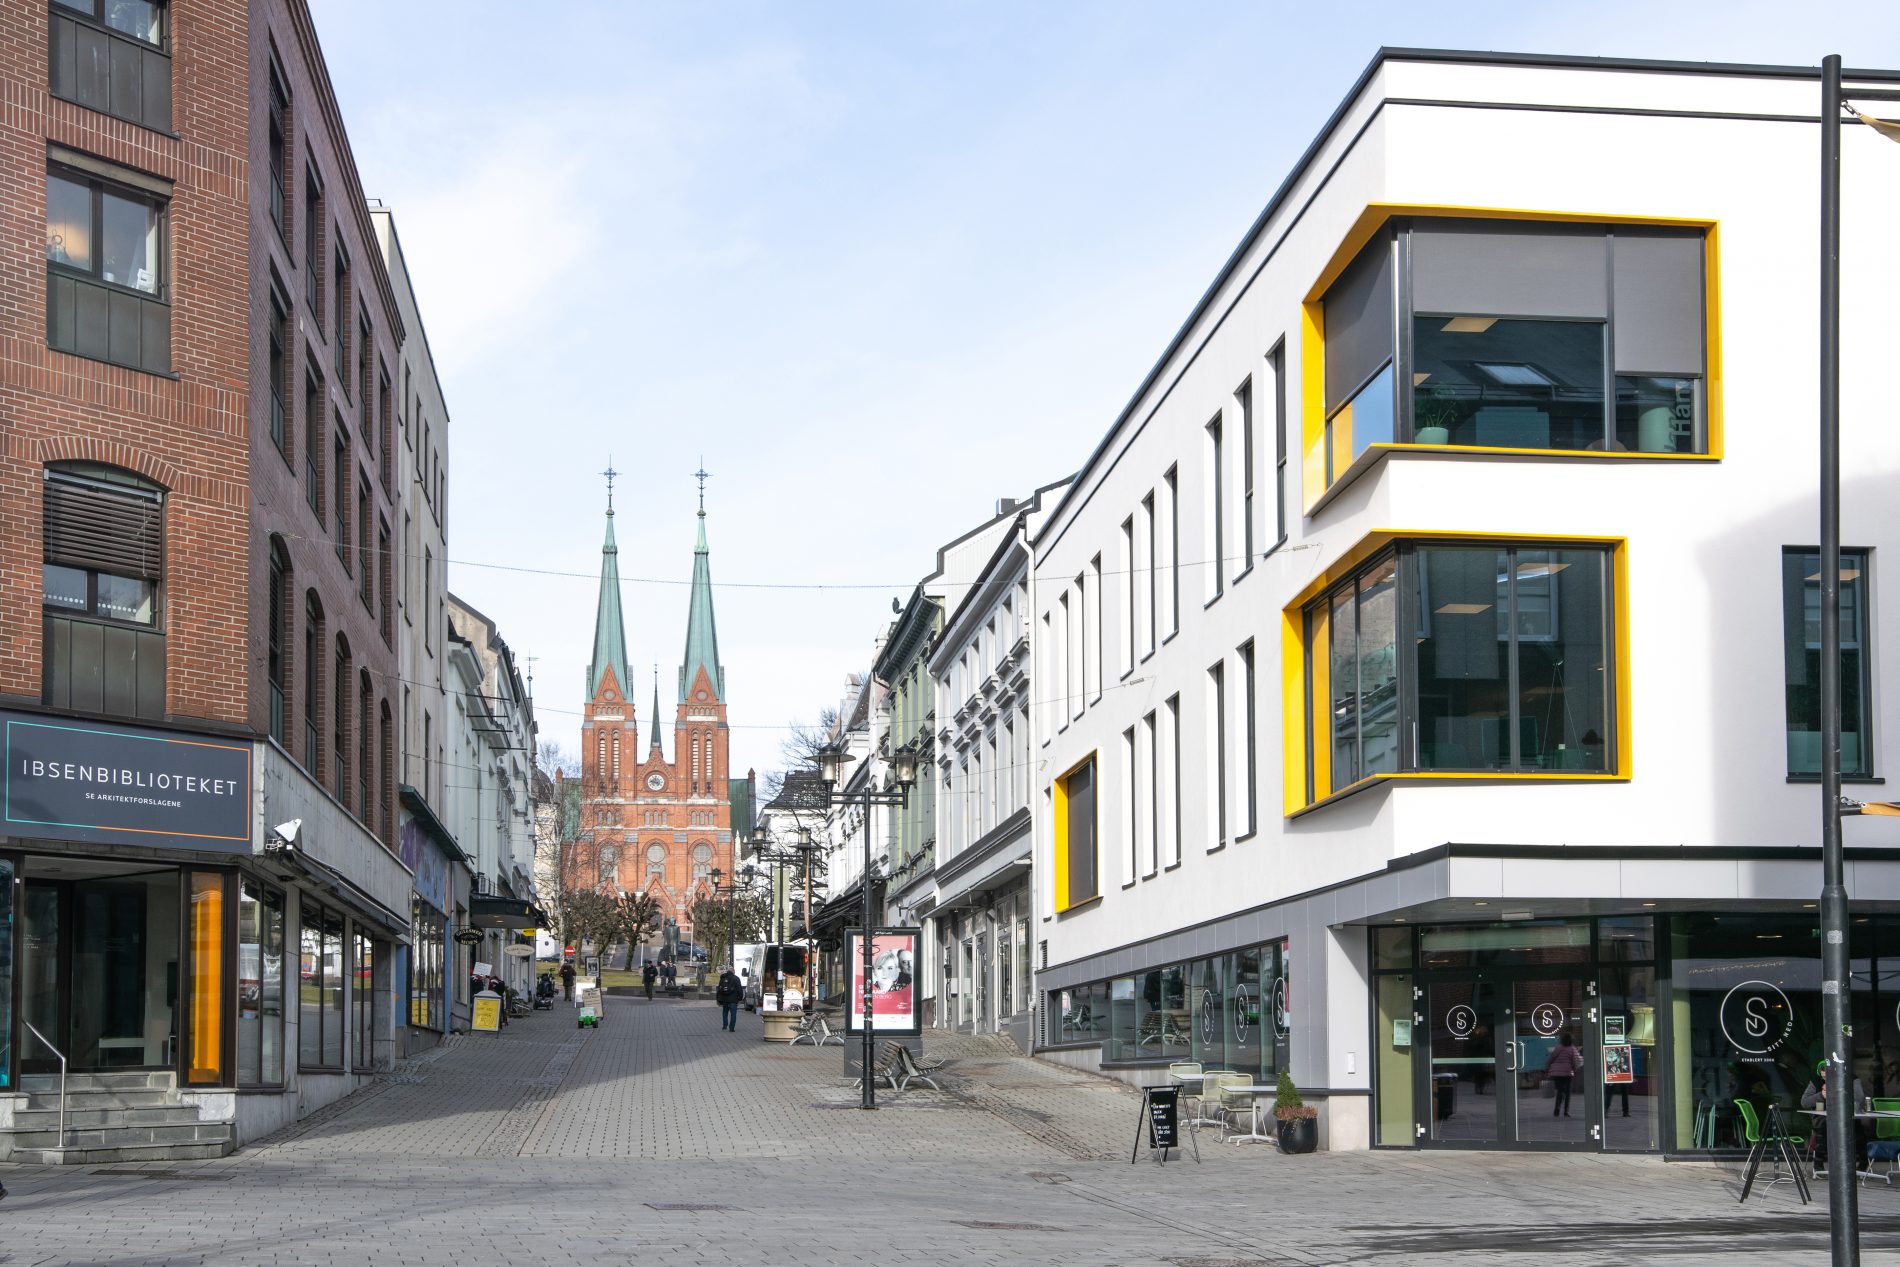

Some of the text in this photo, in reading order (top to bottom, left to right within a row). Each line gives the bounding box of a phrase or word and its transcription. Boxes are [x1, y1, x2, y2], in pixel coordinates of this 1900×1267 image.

[23, 759, 238, 796] IBSENBIBLIOTEKET
[85, 792, 182, 808] SE ARKITEKTFORSLAGENE
[1767, 1038, 1784, 1052] SITT
[1782, 1021, 1793, 1038] NED
